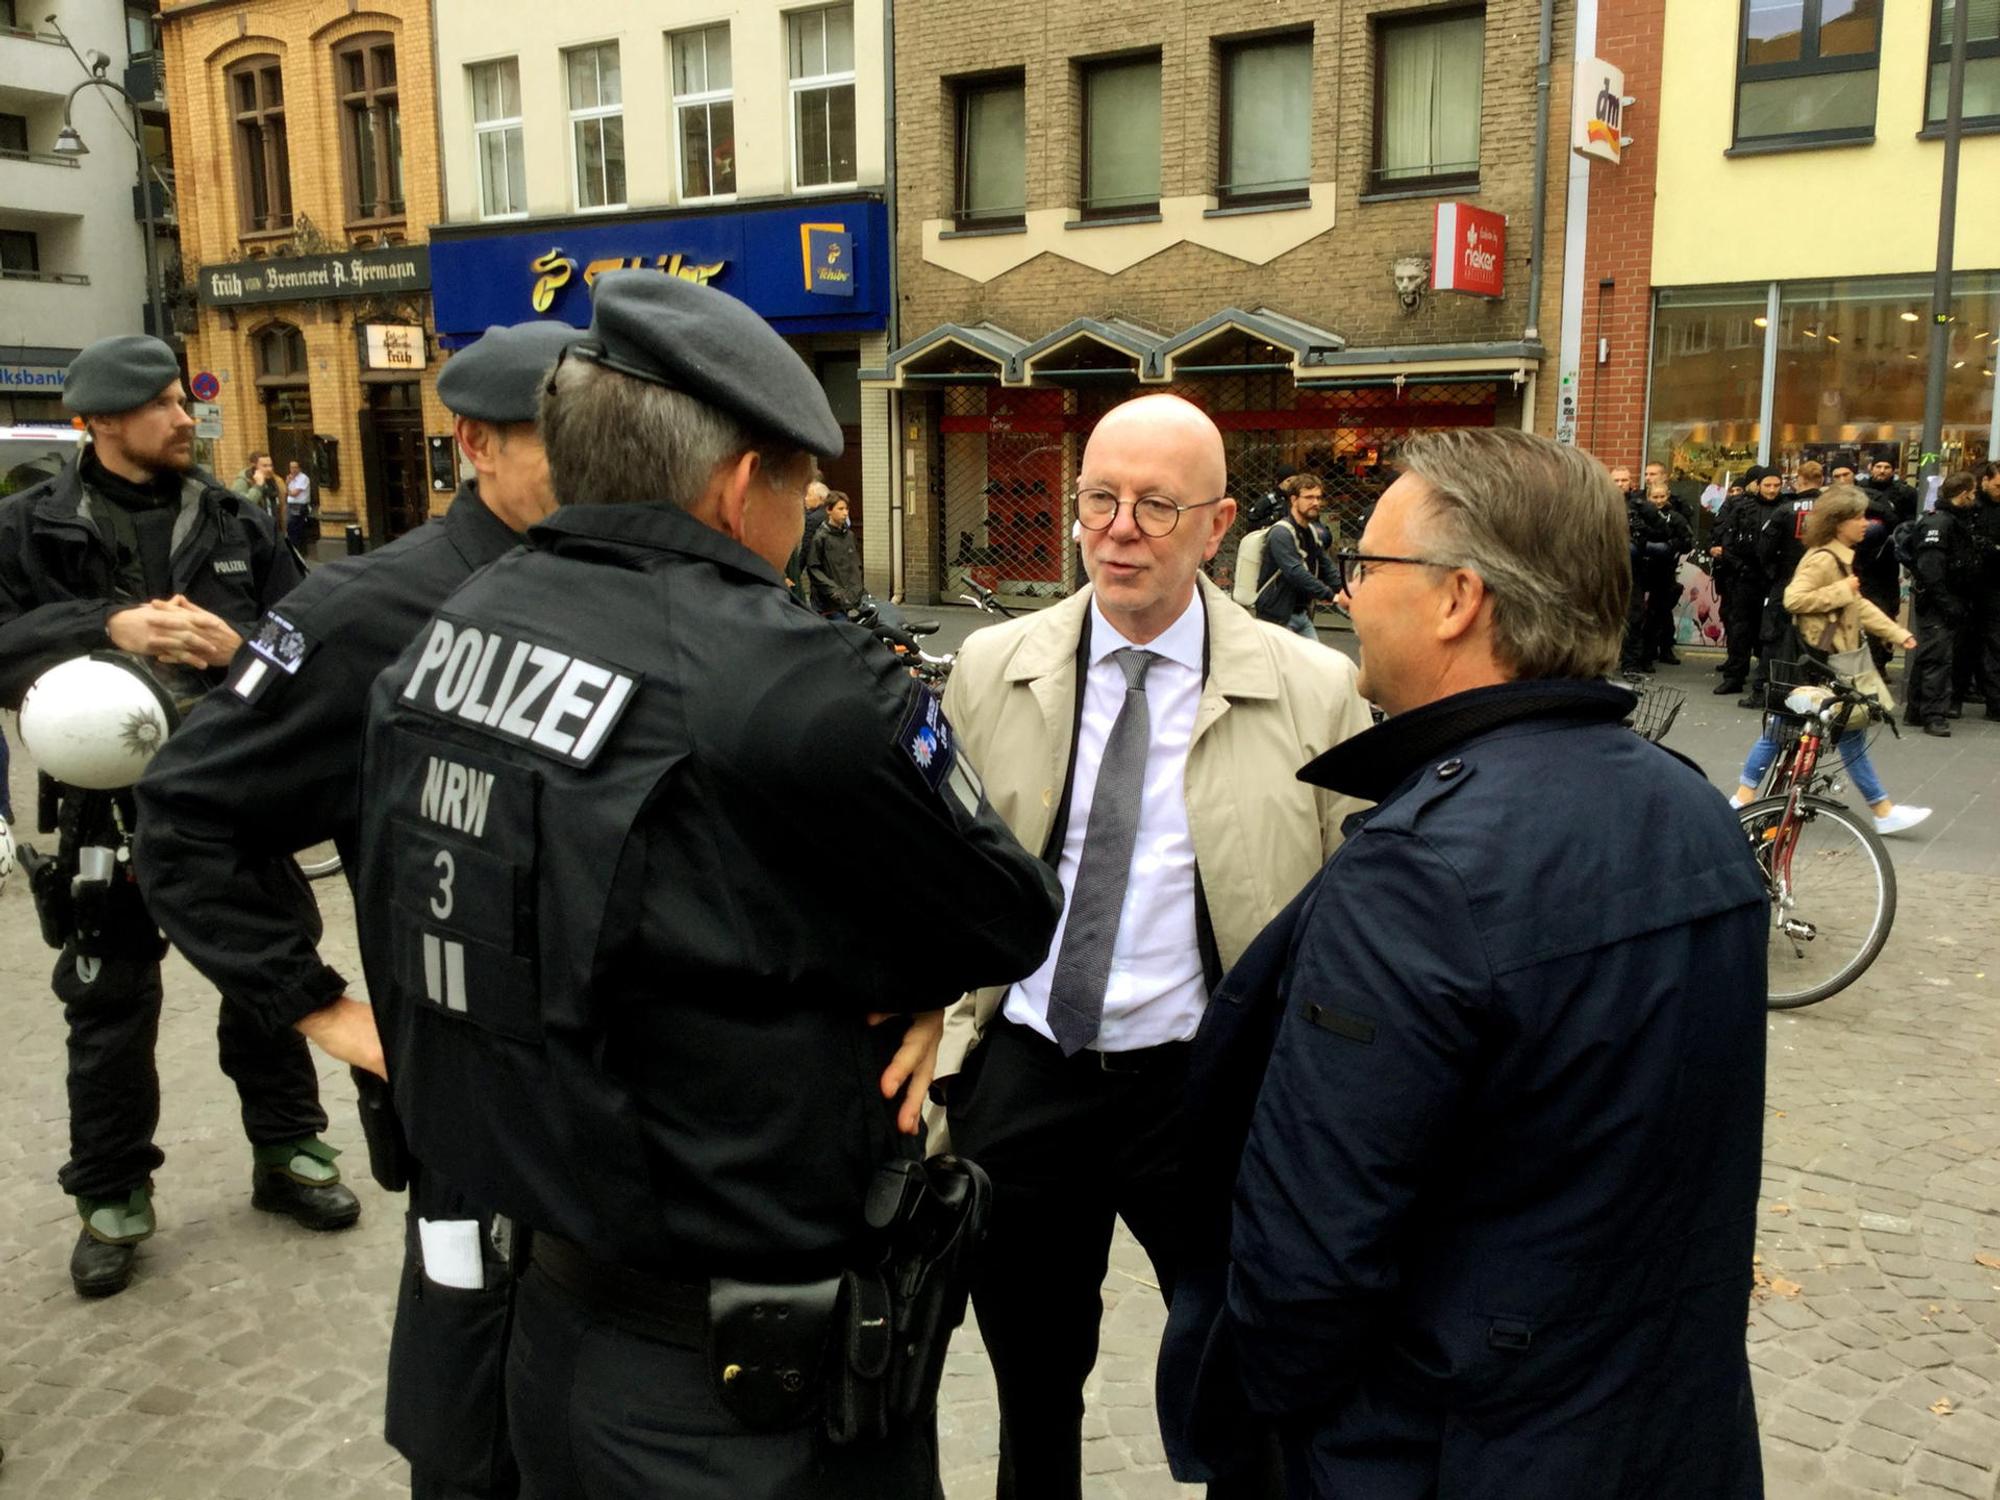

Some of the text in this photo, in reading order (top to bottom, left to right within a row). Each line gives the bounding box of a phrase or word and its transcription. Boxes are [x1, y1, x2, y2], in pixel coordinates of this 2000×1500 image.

[1595, 77, 1620, 129] dm
[266, 263, 330, 290] Brennerei
[350, 258, 416, 288] Hermann
[1464, 244, 1496, 271] rieker
[213, 559, 248, 573] POLIZEI
[402, 618, 634, 761] POLIZEI
[420, 755, 495, 838] NRW
[429, 849, 456, 920] 3
